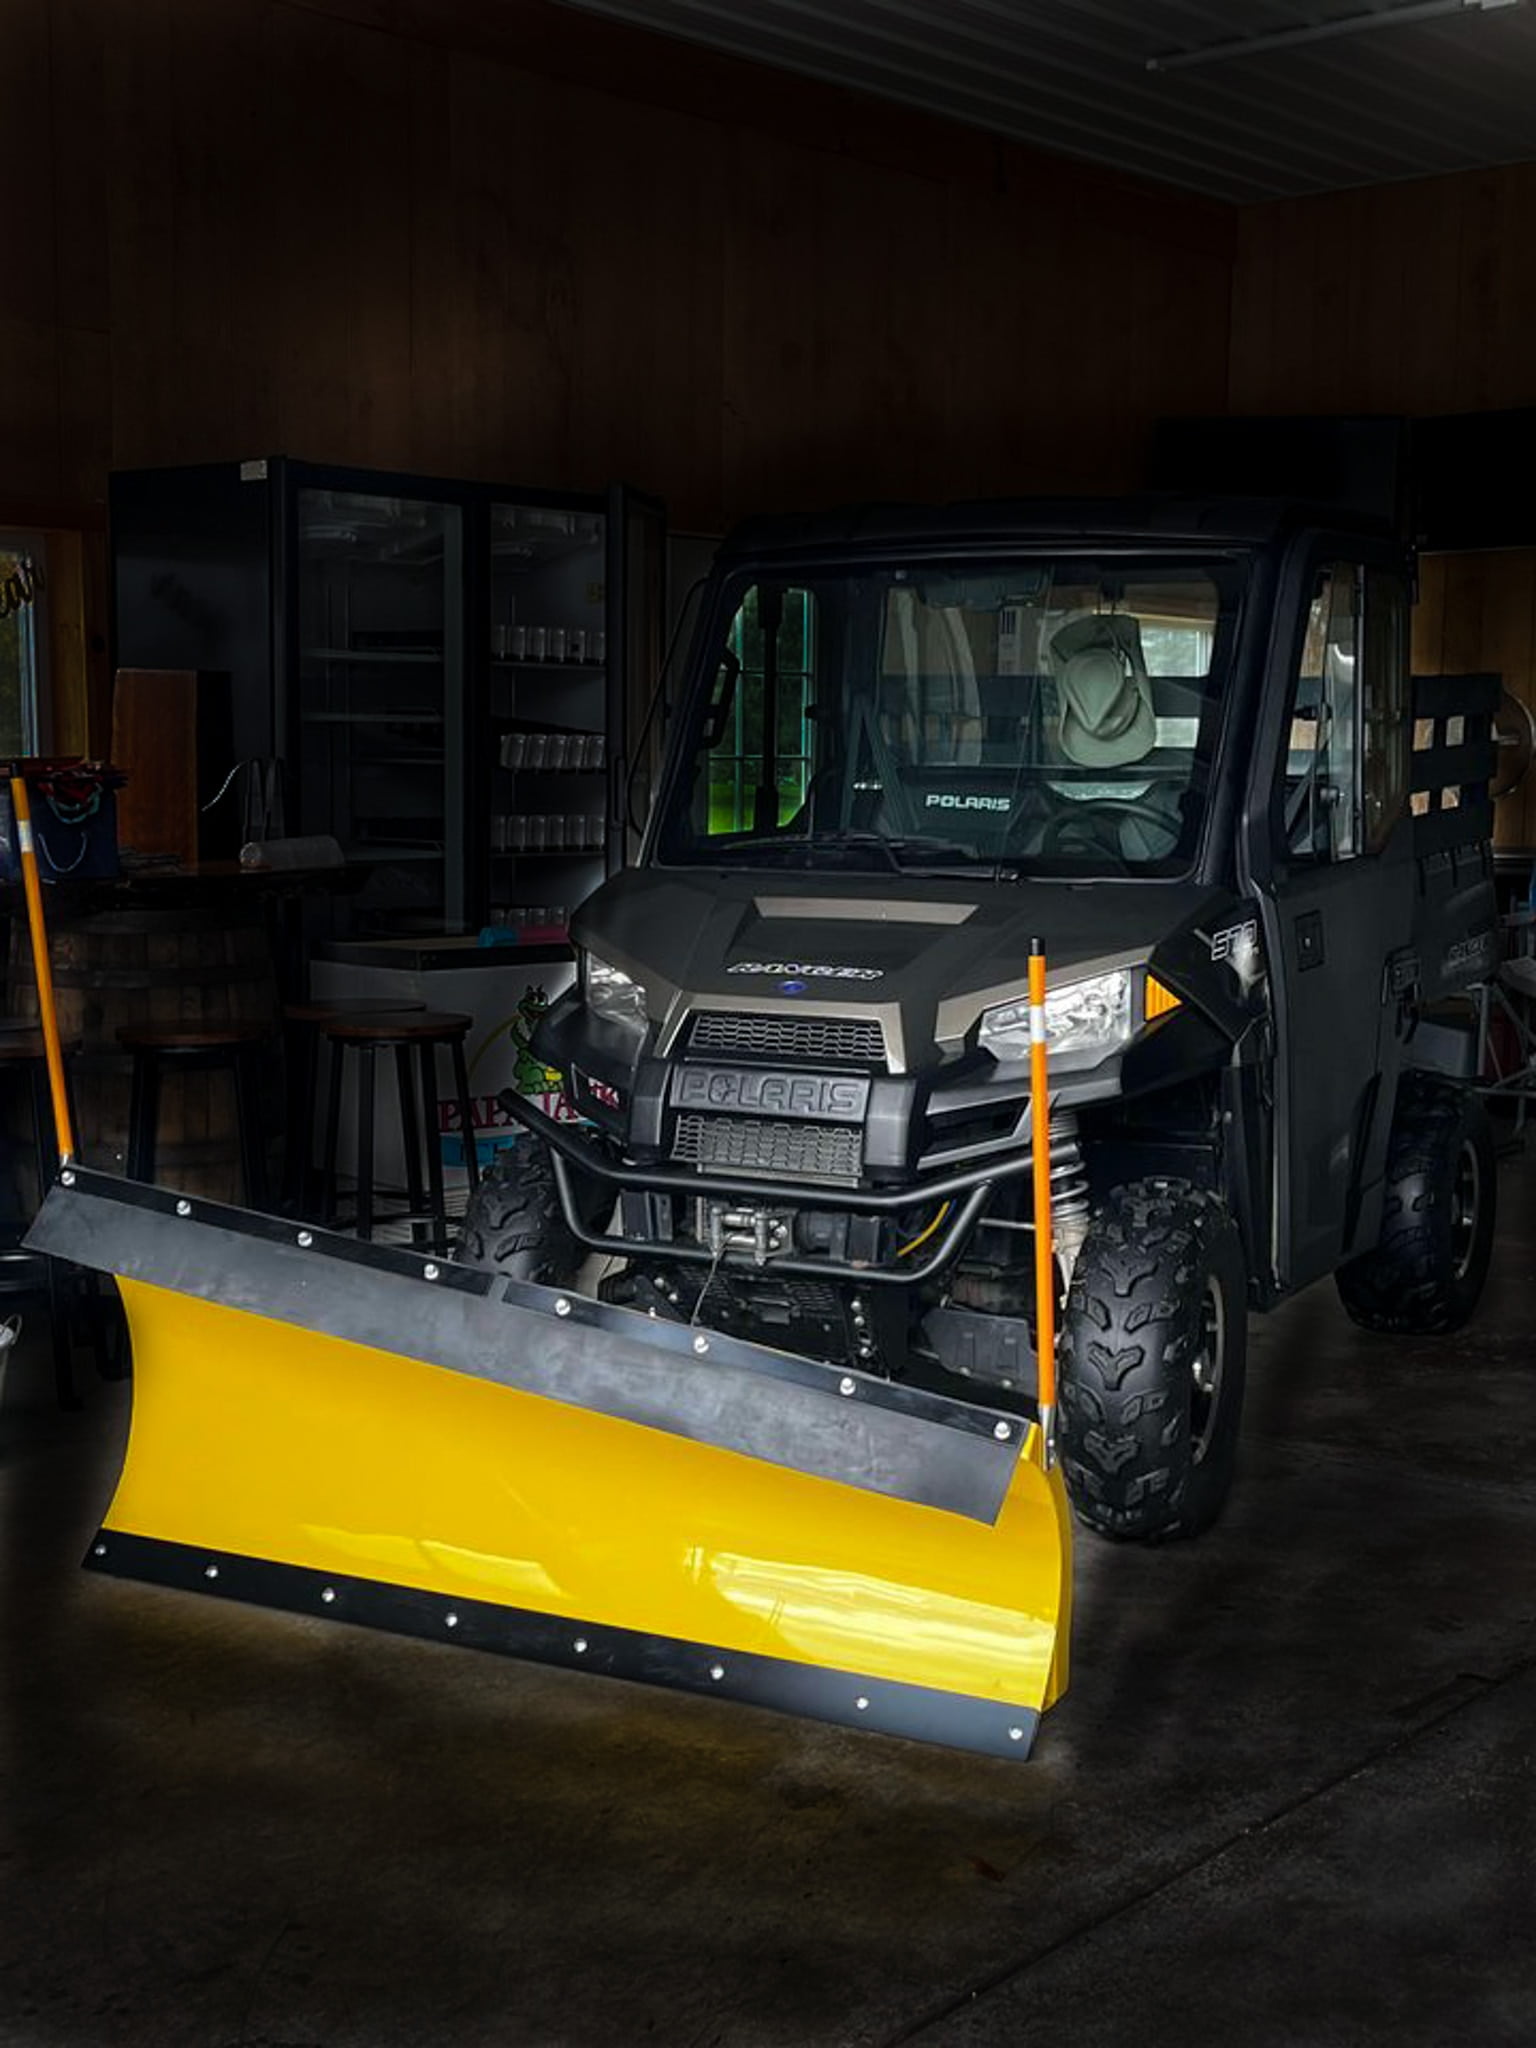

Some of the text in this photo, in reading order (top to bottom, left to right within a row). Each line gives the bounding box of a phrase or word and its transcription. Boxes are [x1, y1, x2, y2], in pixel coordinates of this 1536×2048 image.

[924, 793, 1011, 812] POLARIS
[680, 1071, 864, 1115] POLARIS
[437, 1096, 514, 1133] PAP
